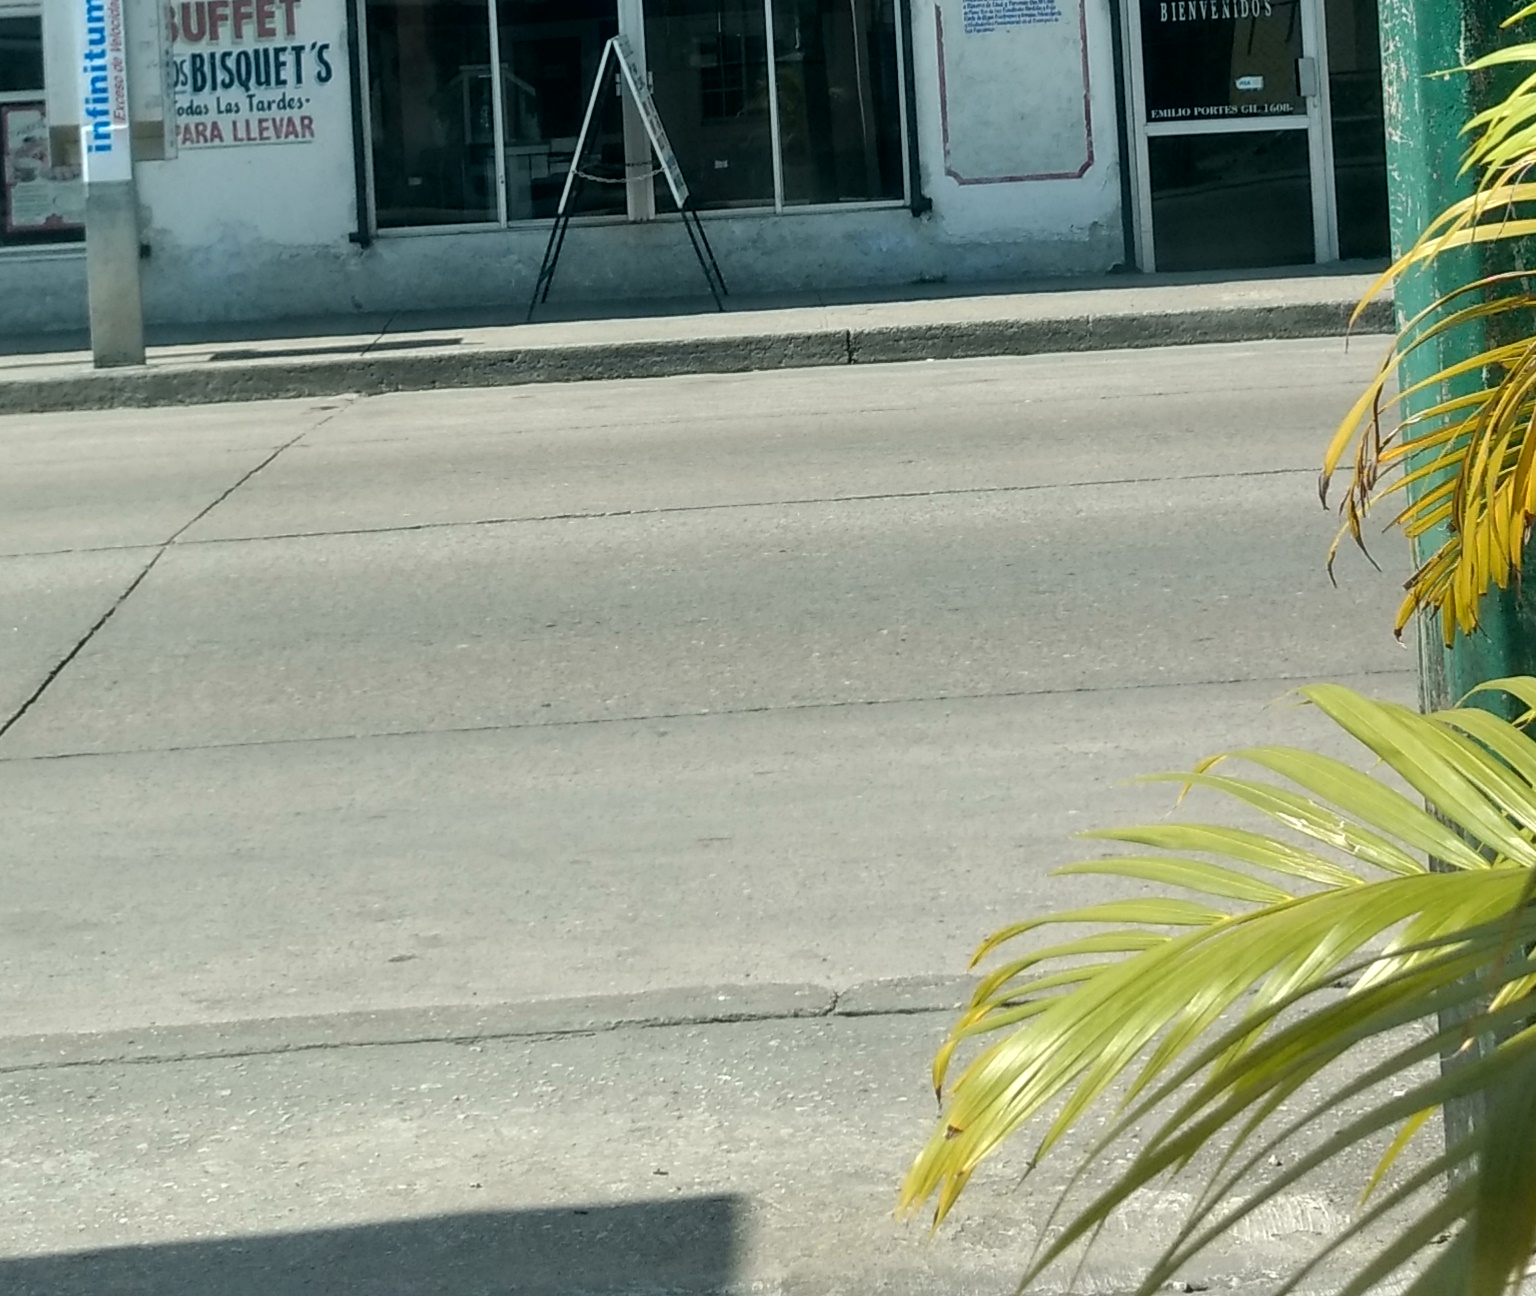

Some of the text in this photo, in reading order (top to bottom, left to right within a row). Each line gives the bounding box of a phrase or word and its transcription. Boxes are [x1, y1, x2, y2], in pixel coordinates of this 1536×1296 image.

[190, 41, 333, 93] BISQUET'S
[113, 75, 126, 121] Exceso
[174, 99, 210, 117] odas
[216, 95, 241, 115] Las
[1151, 107, 1191, 119] EMILIO
[1194, 104, 1238, 116] PORTES
[231, 115, 315, 142] LLEVAR
